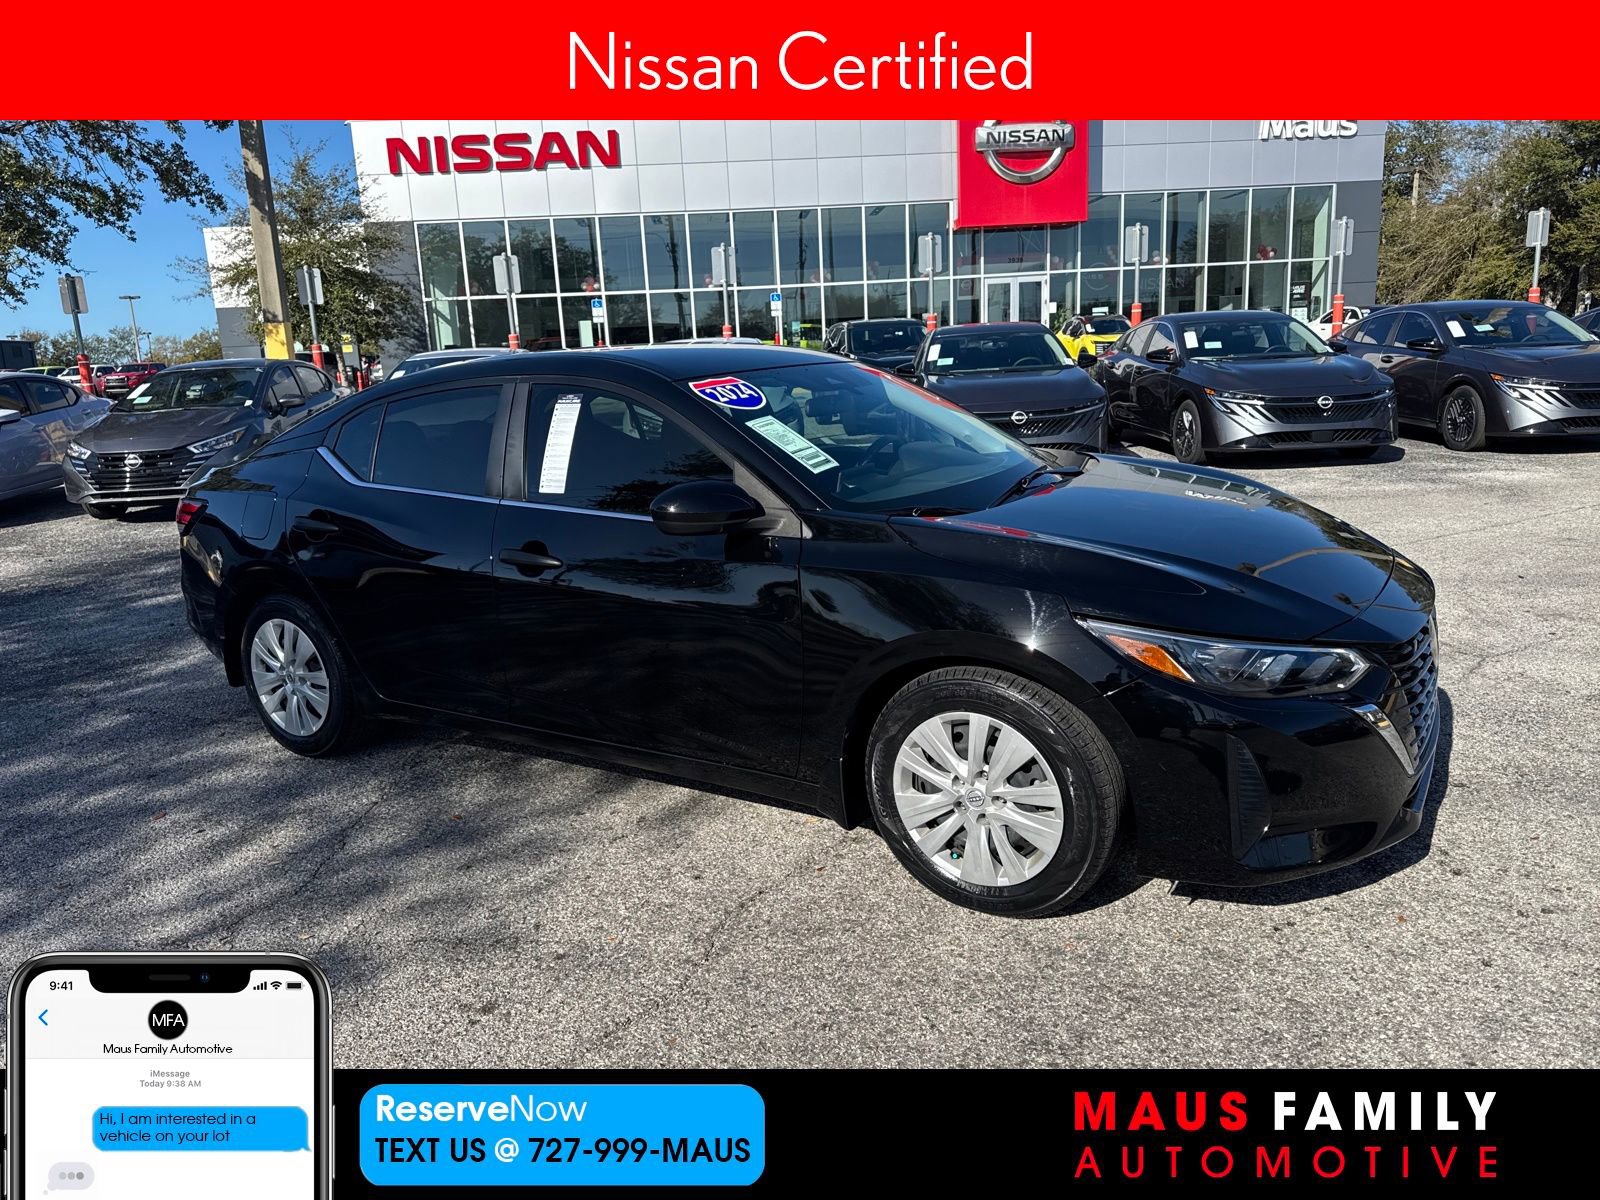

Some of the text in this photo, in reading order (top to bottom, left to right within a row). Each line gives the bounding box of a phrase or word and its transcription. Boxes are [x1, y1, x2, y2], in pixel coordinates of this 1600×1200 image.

[985, 128, 1066, 145] NISSAN
[1260, 120, 1359, 140] Maus
[386, 129, 620, 174] NISSAN
[704, 383, 759, 403] 2024
